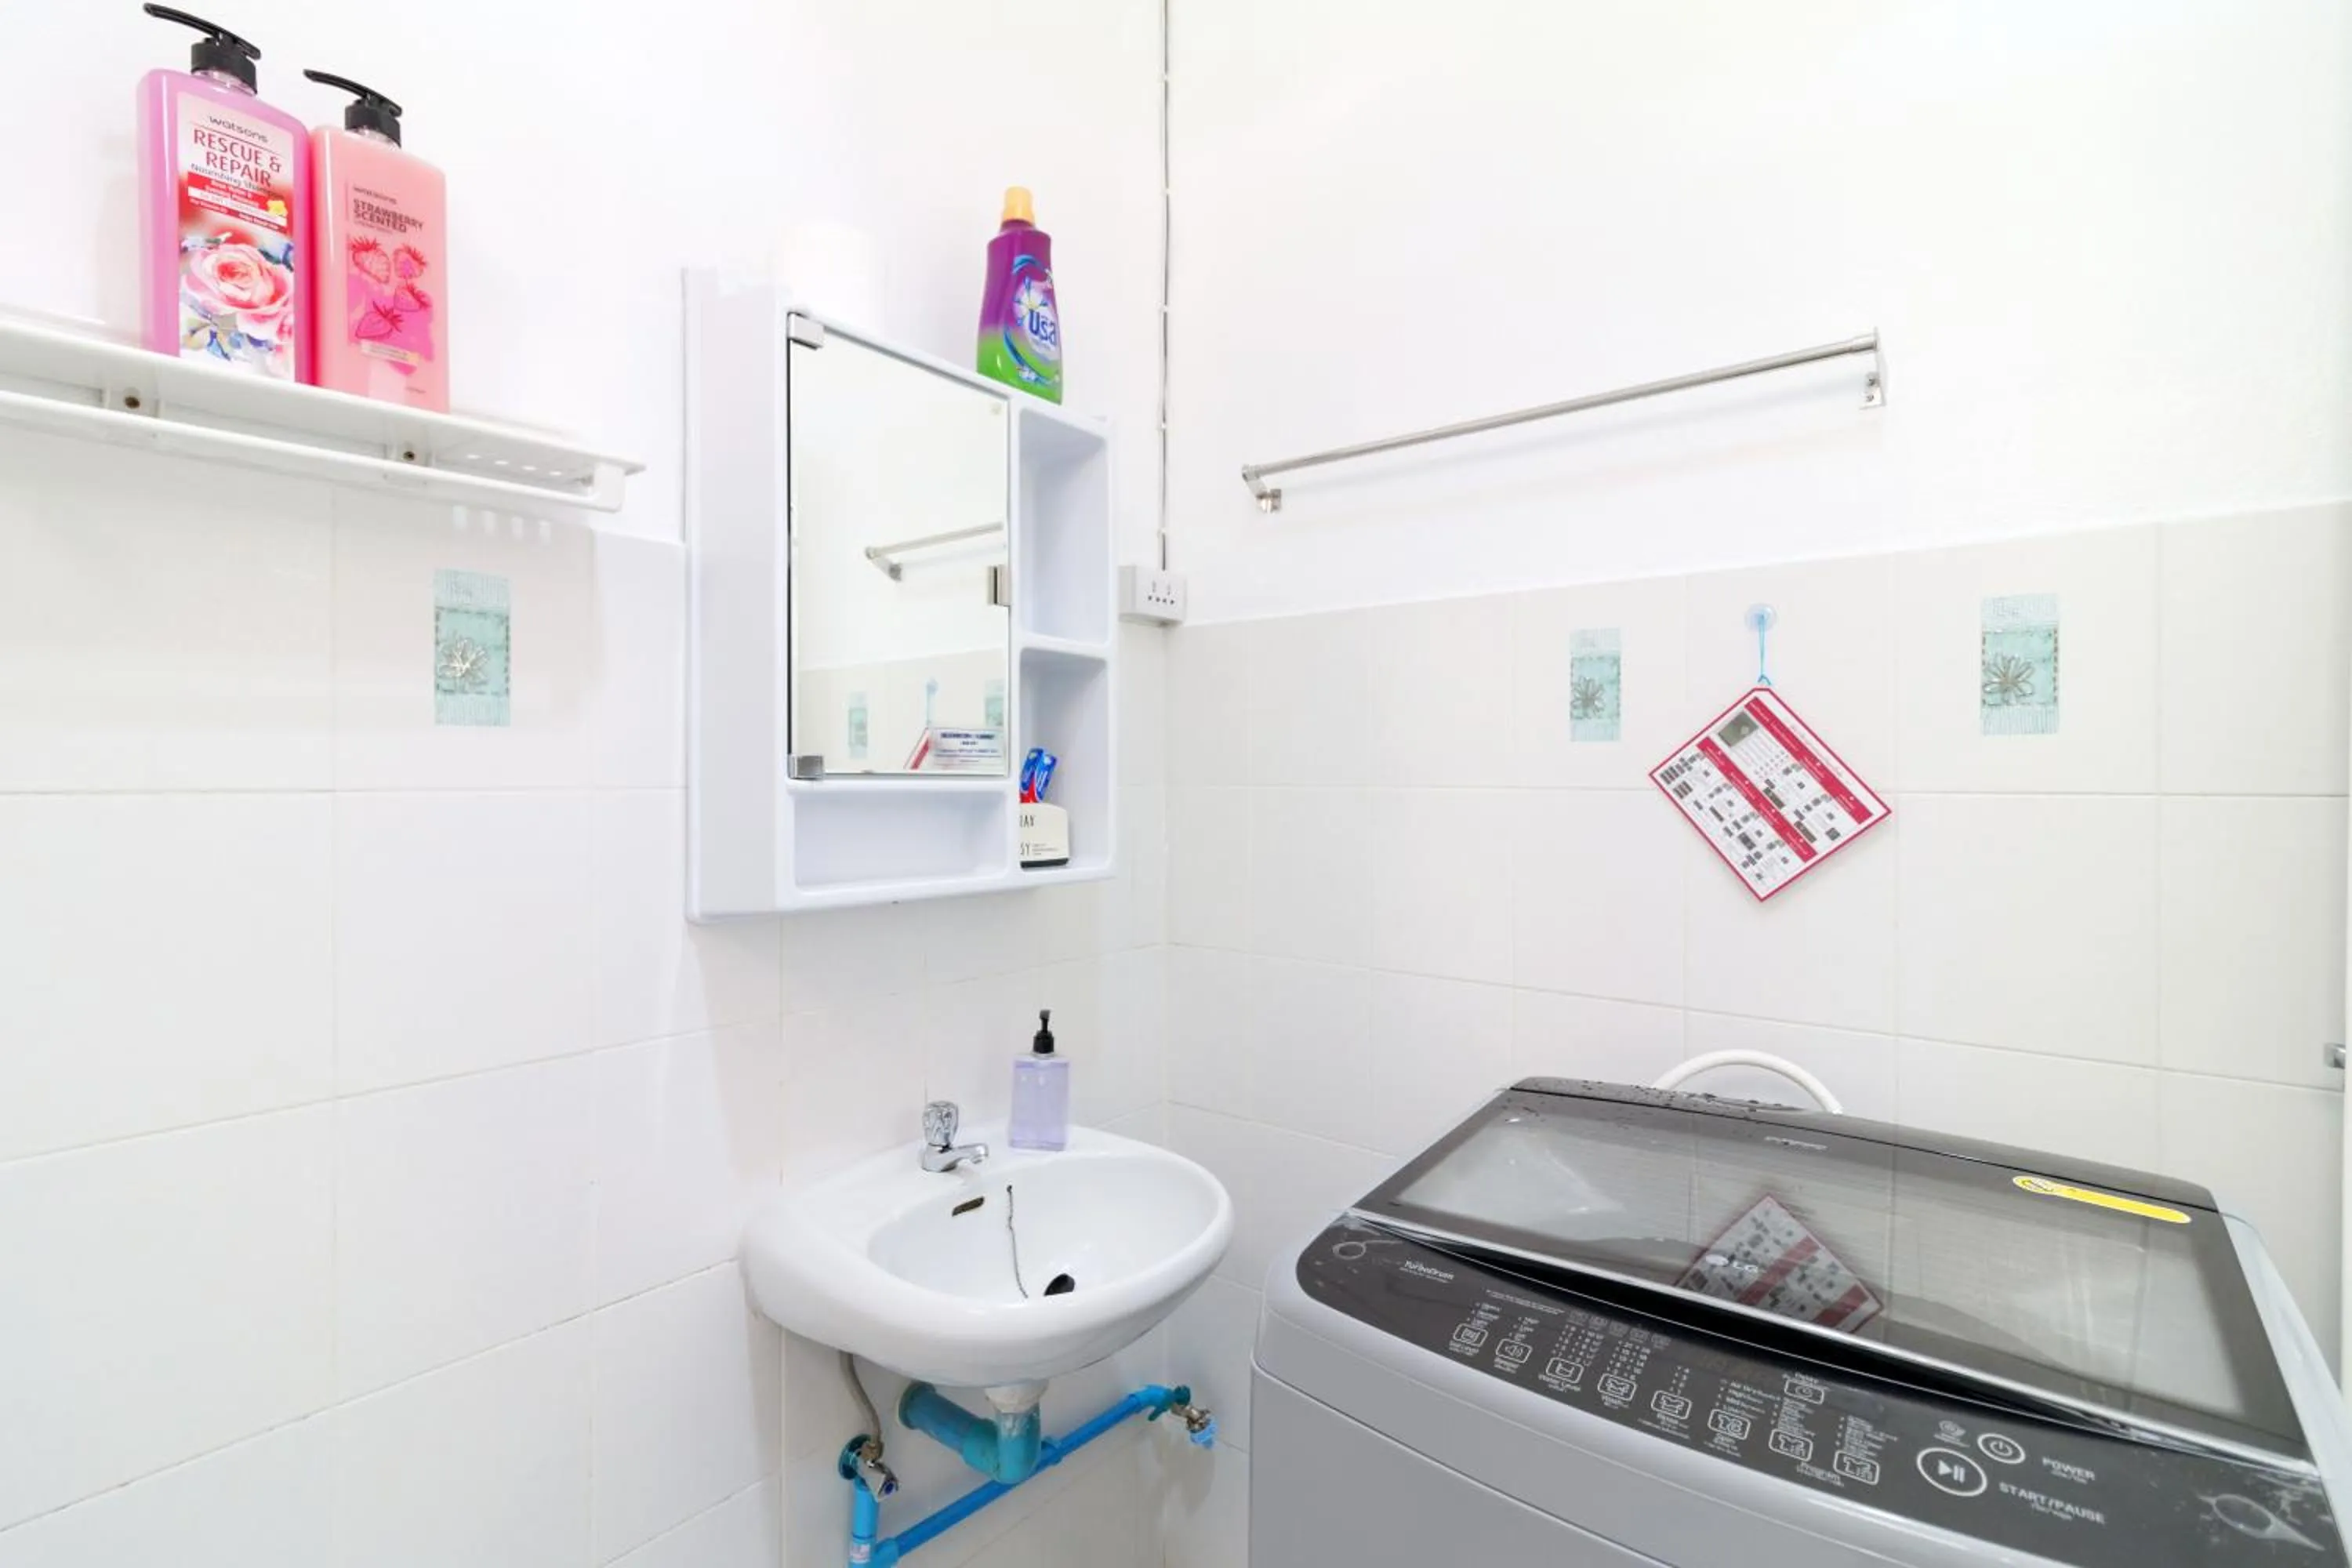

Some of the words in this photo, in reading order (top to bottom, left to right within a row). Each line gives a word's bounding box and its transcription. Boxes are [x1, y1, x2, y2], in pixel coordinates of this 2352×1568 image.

[209, 116, 268, 143] watsons
[194, 129, 263, 165] RESCUE
[269, 155, 282, 172] &
[206, 151, 272, 187] REPAIR
[353, 198, 424, 231] STRAWBERRY
[354, 209, 407, 234] SCENTED
[2042, 1456, 2096, 1481] POWER
[1998, 1481, 2107, 1525] START/PAUSE
